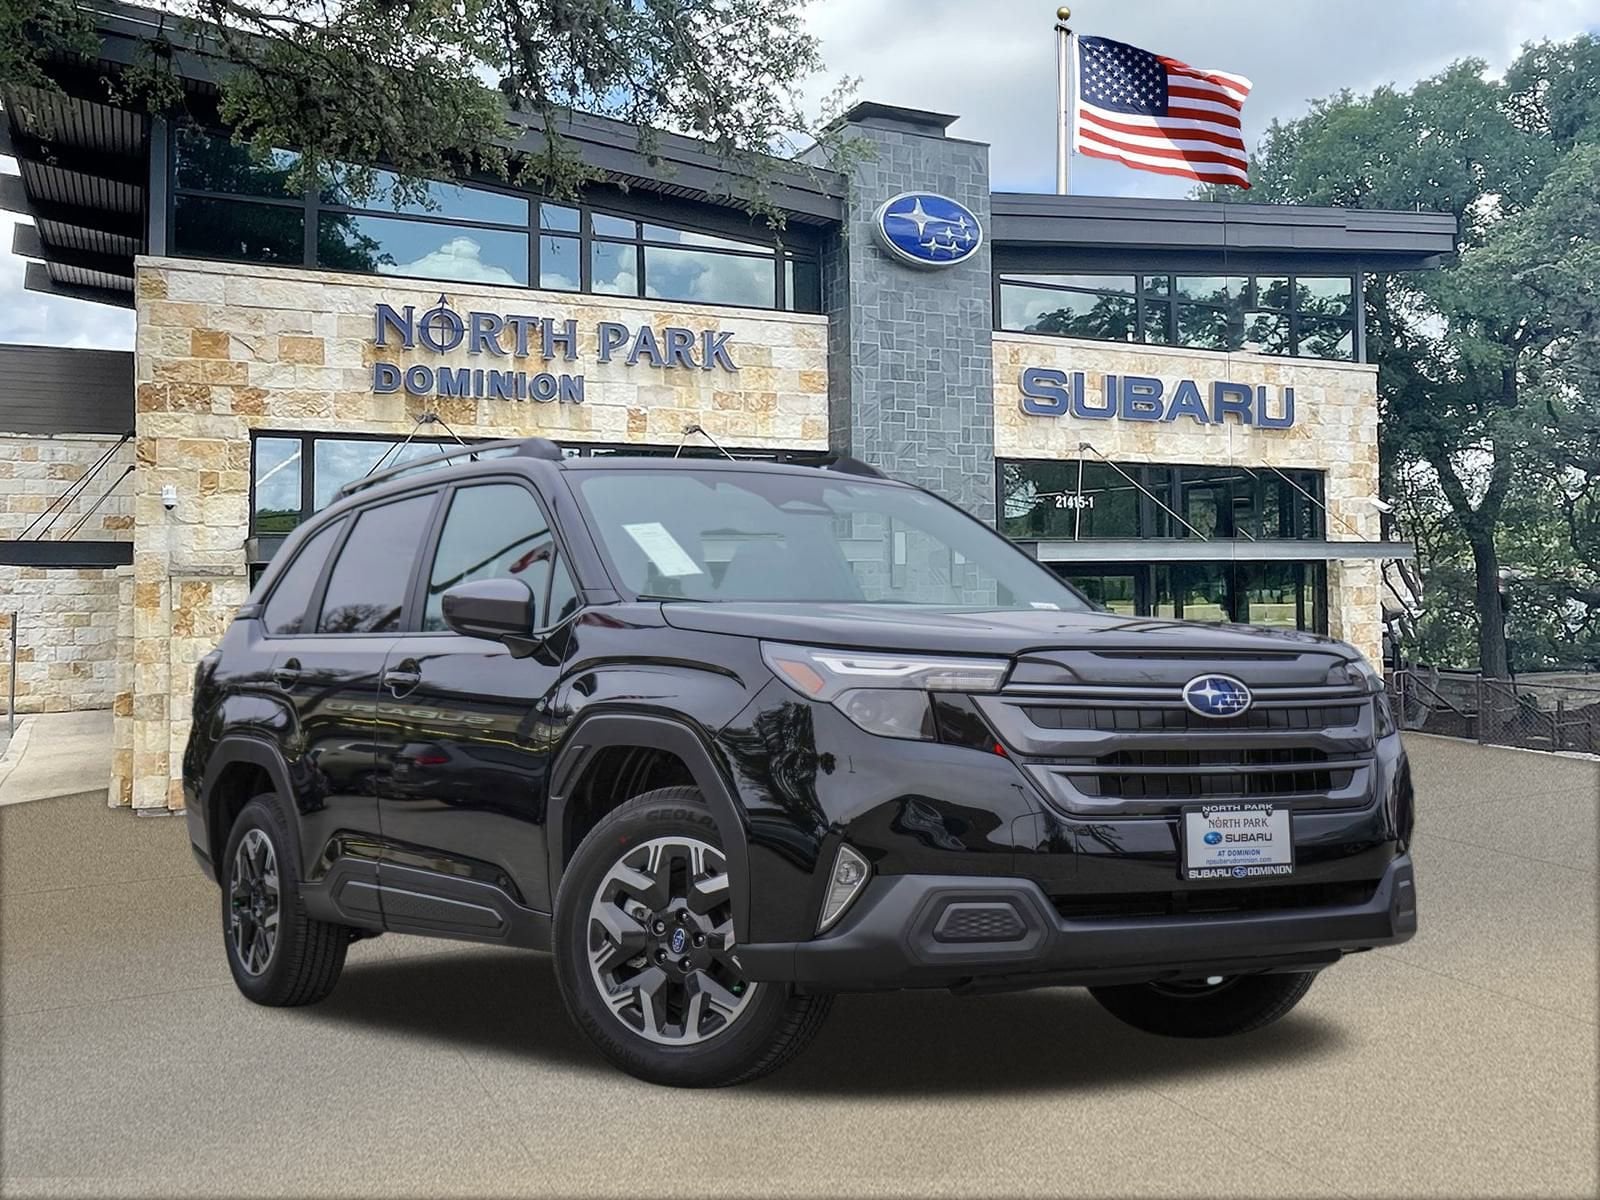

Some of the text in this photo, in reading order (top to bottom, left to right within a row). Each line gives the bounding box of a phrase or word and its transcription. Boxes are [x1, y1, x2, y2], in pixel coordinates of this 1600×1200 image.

[375, 294, 741, 373] NORTH PARK
[373, 362, 585, 404] DOMINION
[1019, 367, 1295, 430] SUBARU
[1208, 817, 1269, 828] NORTH PARK
[1225, 832, 1273, 843] SUBARU
[1227, 849, 1261, 857] DOMINION
[1188, 865, 1293, 878] SUBARU DOMINION
